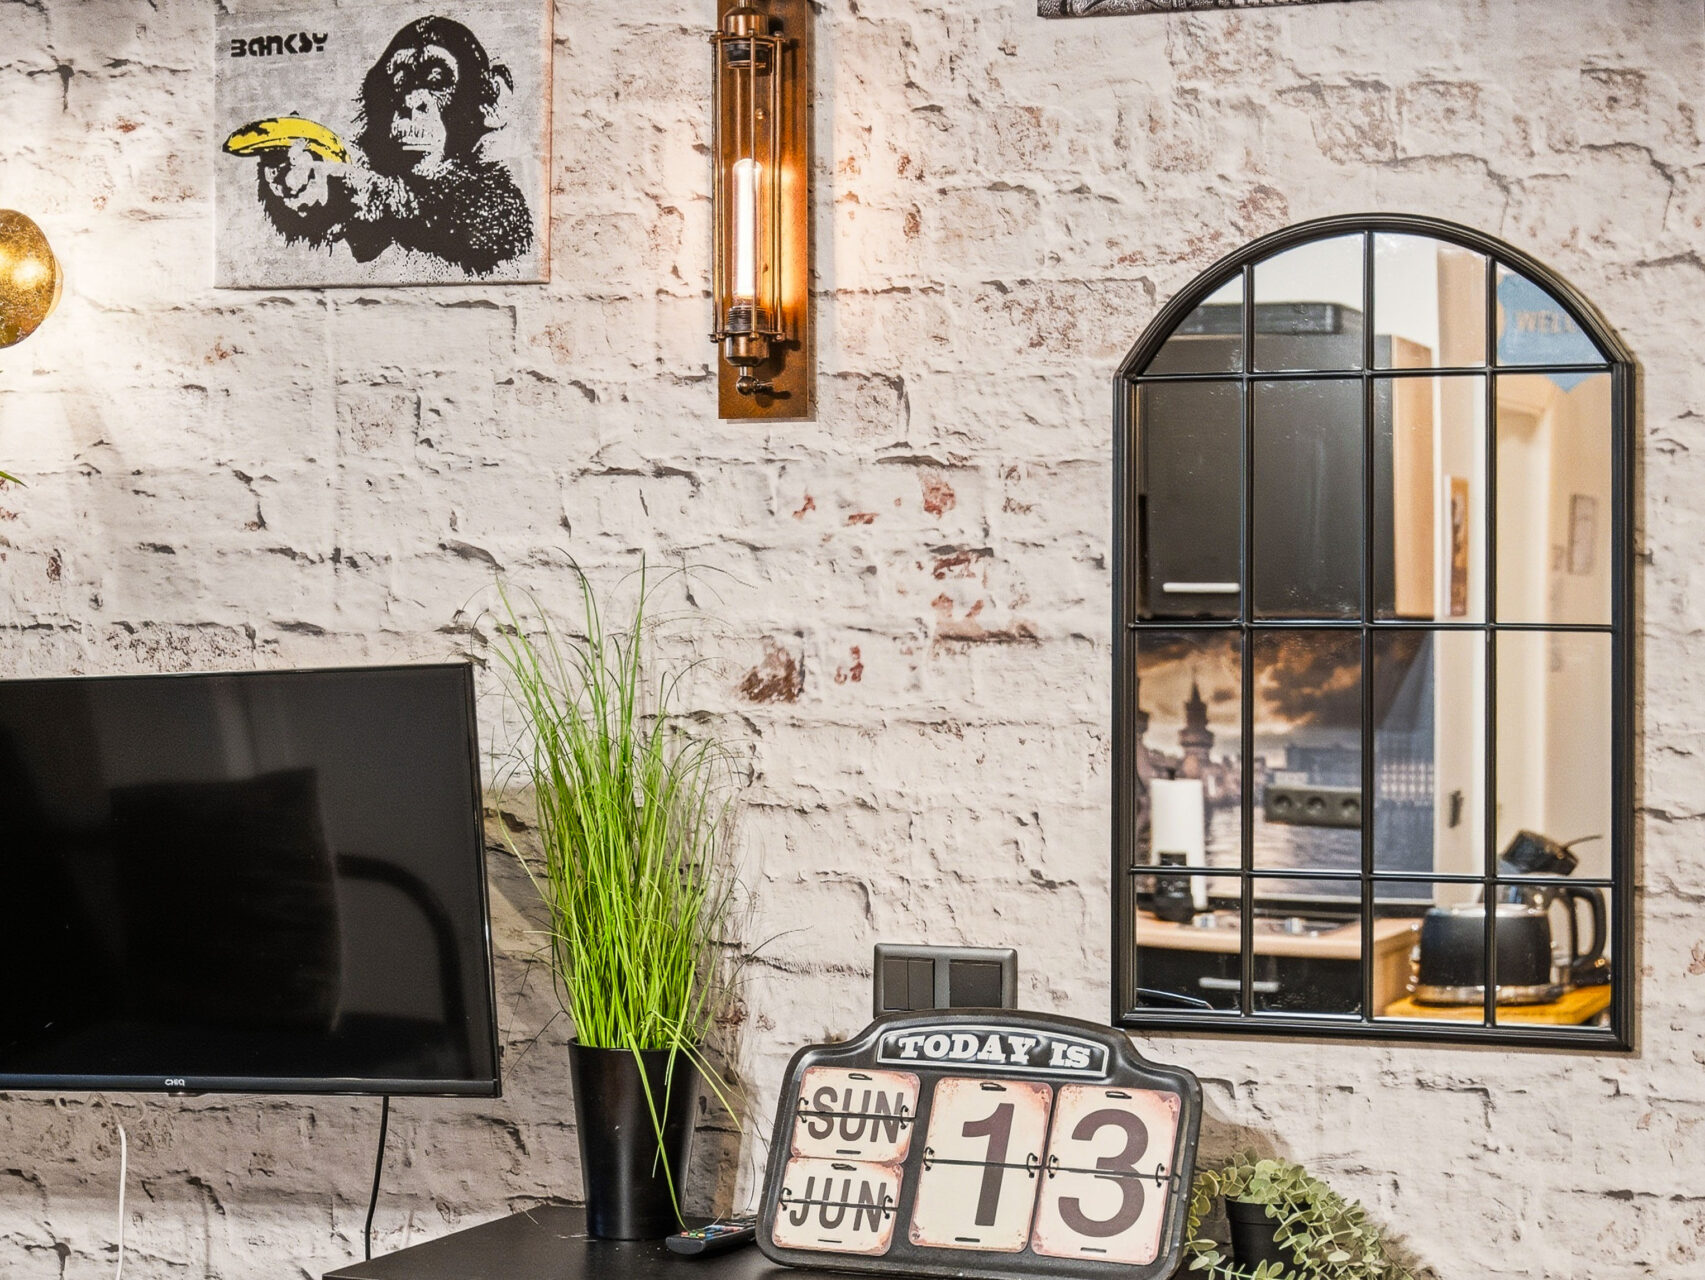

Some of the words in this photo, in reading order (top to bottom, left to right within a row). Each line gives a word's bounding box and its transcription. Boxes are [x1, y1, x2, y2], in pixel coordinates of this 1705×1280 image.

[899, 1033, 1036, 1065] TODAY
[1050, 1042, 1090, 1069] IS
[807, 1086, 904, 1144] SUN
[789, 1176, 887, 1233] JUN
